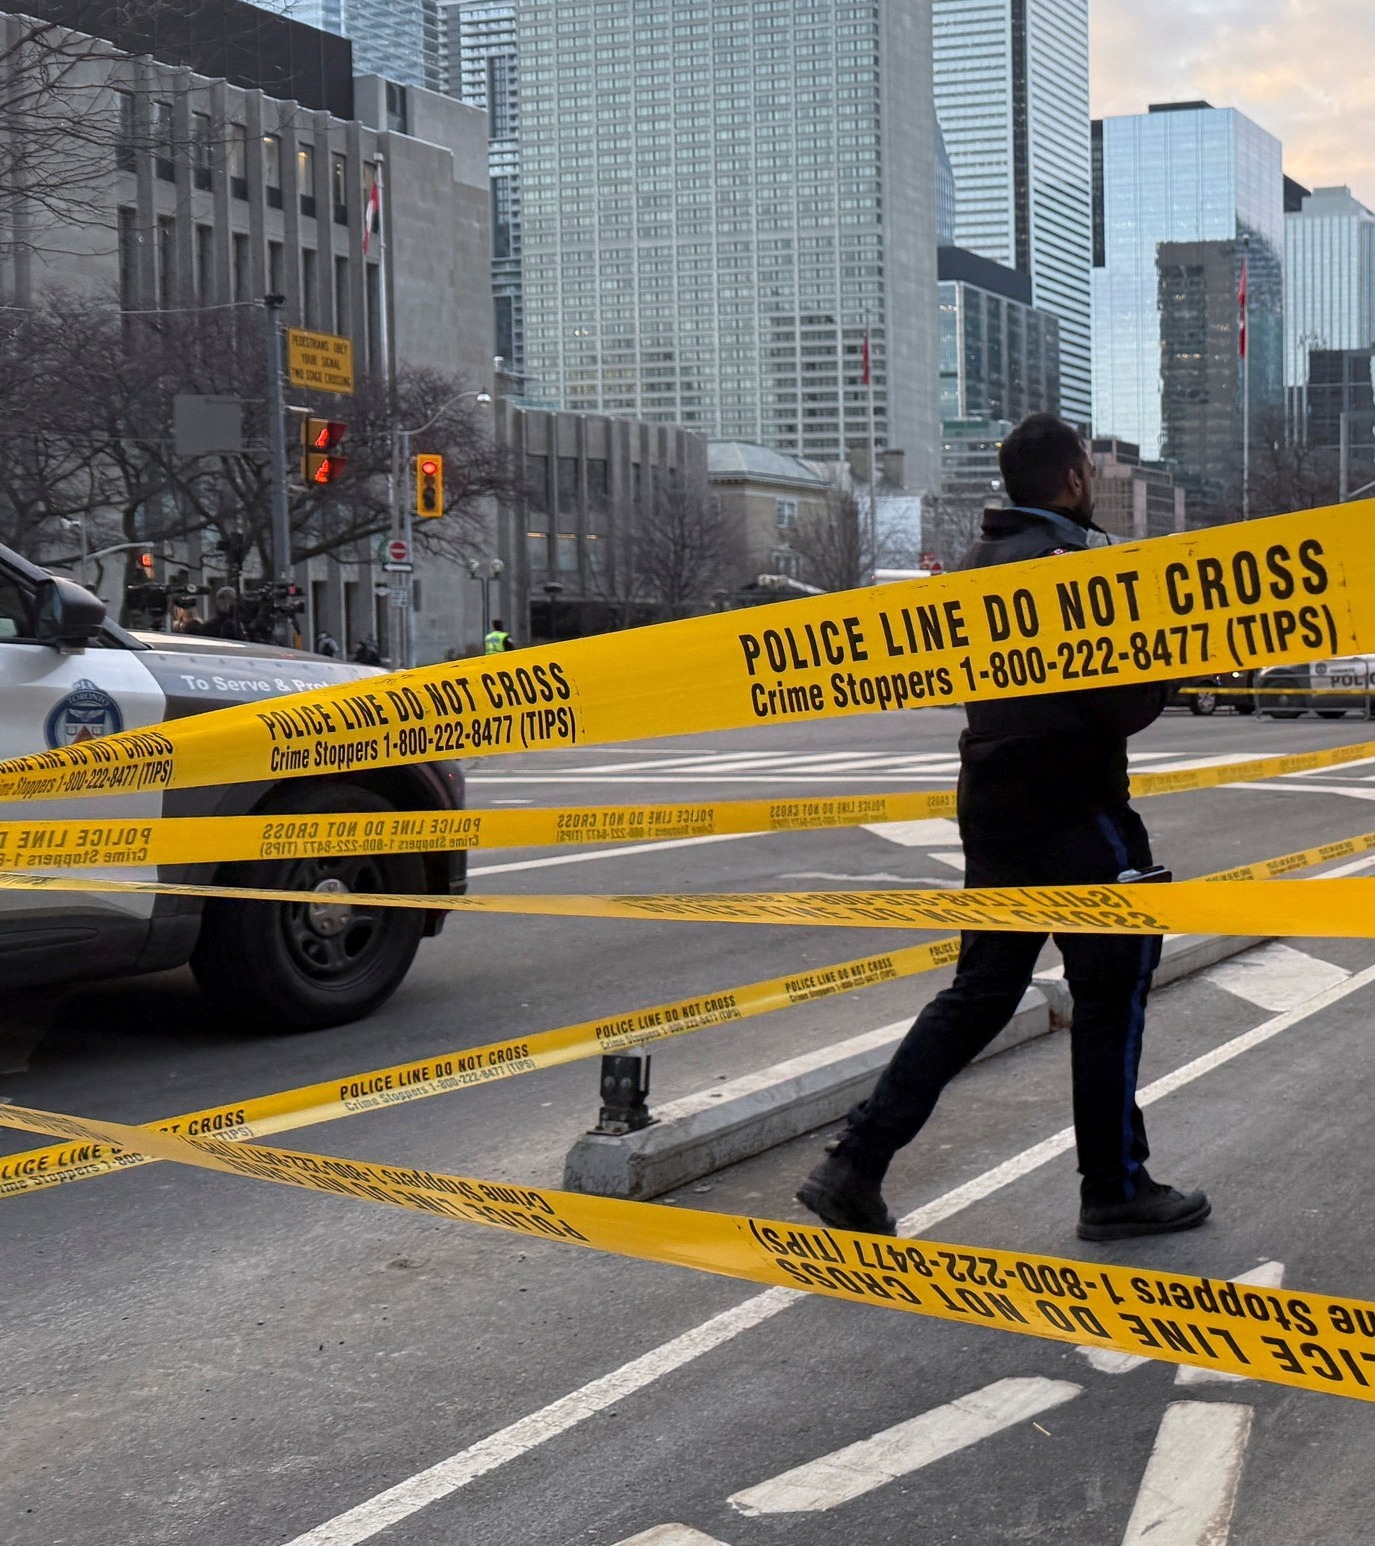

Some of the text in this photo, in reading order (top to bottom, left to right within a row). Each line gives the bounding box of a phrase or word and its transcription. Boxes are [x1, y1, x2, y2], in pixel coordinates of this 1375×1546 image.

[292, 335, 328, 351] PEDESTRIANS
[302, 353, 341, 371] YOUR SIGNAL
[292, 367, 351, 387] TWO STAGE CROSSING
[738, 539, 1328, 676] POLICE LINE DO NOT CROSS
[751, 603, 1338, 717] Crime Stoppers 1-800-222-8477 (TIPS)
[180, 674, 208, 690] To
[212, 676, 271, 692] Serve
[273, 678, 292, 692] &
[257, 662, 571, 741] POLICE LINE DO NOT CROSS
[63, 746, 88, 765] DO
[84, 741, 120, 763] NOT
[114, 732, 173, 759] CROSS
[271, 706, 576, 772] Crime Stoppers 1-800-222-8477 (TIPS)
[13, 777, 56, 799] Stoppers
[55, 765, 139, 792] 1-800-222-8477
[137, 760, 173, 790] (TIPS)
[785, 976, 816, 993] POLICE
[817, 971, 836, 985] LINE
[838, 968, 849, 980] DO
[851, 963, 866, 977] NOT
[868, 957, 893, 972] CROSS
[595, 995, 737, 1039] POLICE LINE DO NOT CROSS
[339, 1044, 529, 1101] POLICE LINE DO NOT CROSS
[344, 1059, 536, 1112] Crime Stoppers 1-800-222-8477 (TIPS)
[188, 1109, 245, 1136] CROSS
[58, 1145, 101, 1166] LINE
[248, 1149, 387, 1185] 1-800-222-8477
[31, 1164, 100, 1188] Stoppers
[297, 1171, 361, 1197] NOT
[350, 1182, 404, 1206] DO
[380, 1169, 485, 1203] Stoppers
[391, 1189, 473, 1219] LINE
[478, 1184, 555, 1215] Crime
[464, 1202, 590, 1242] POLICE
[748, 1219, 845, 1264] (TIPS)
[776, 1258, 923, 1305] CROSS
[853, 1240, 1125, 1306] 1-800-222-8477
[930, 1282, 1030, 1325] NOT
[1035, 1299, 1113, 1340] DO
[1130, 1277, 1318, 1337] Stoppers
[1118, 1312, 1251, 1365] LINE
